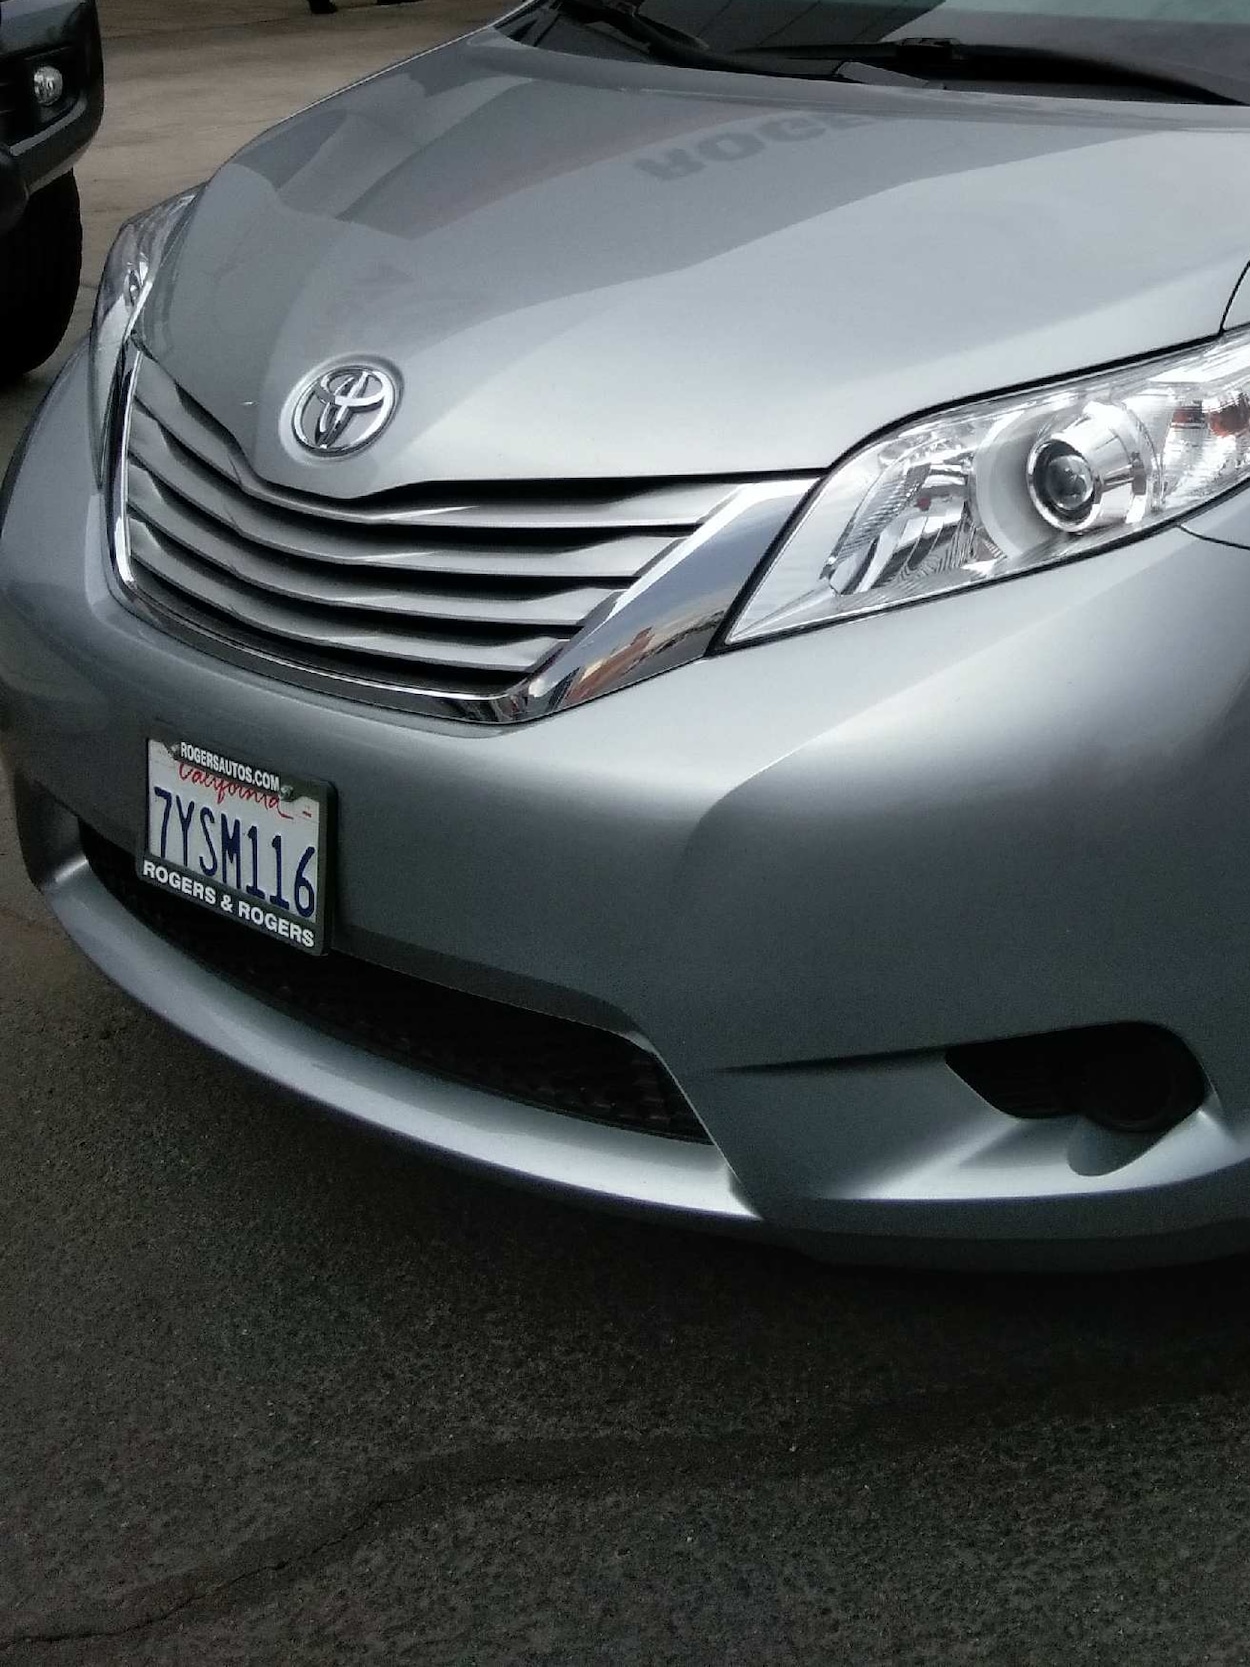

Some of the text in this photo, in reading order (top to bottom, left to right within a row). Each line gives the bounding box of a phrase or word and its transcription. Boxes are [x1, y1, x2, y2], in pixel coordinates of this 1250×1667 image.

[180, 741, 280, 792] ROGERSAUTOS.COM
[154, 786, 316, 918] 7YSM116
[143, 859, 315, 949] ROGERS & ROGERS
